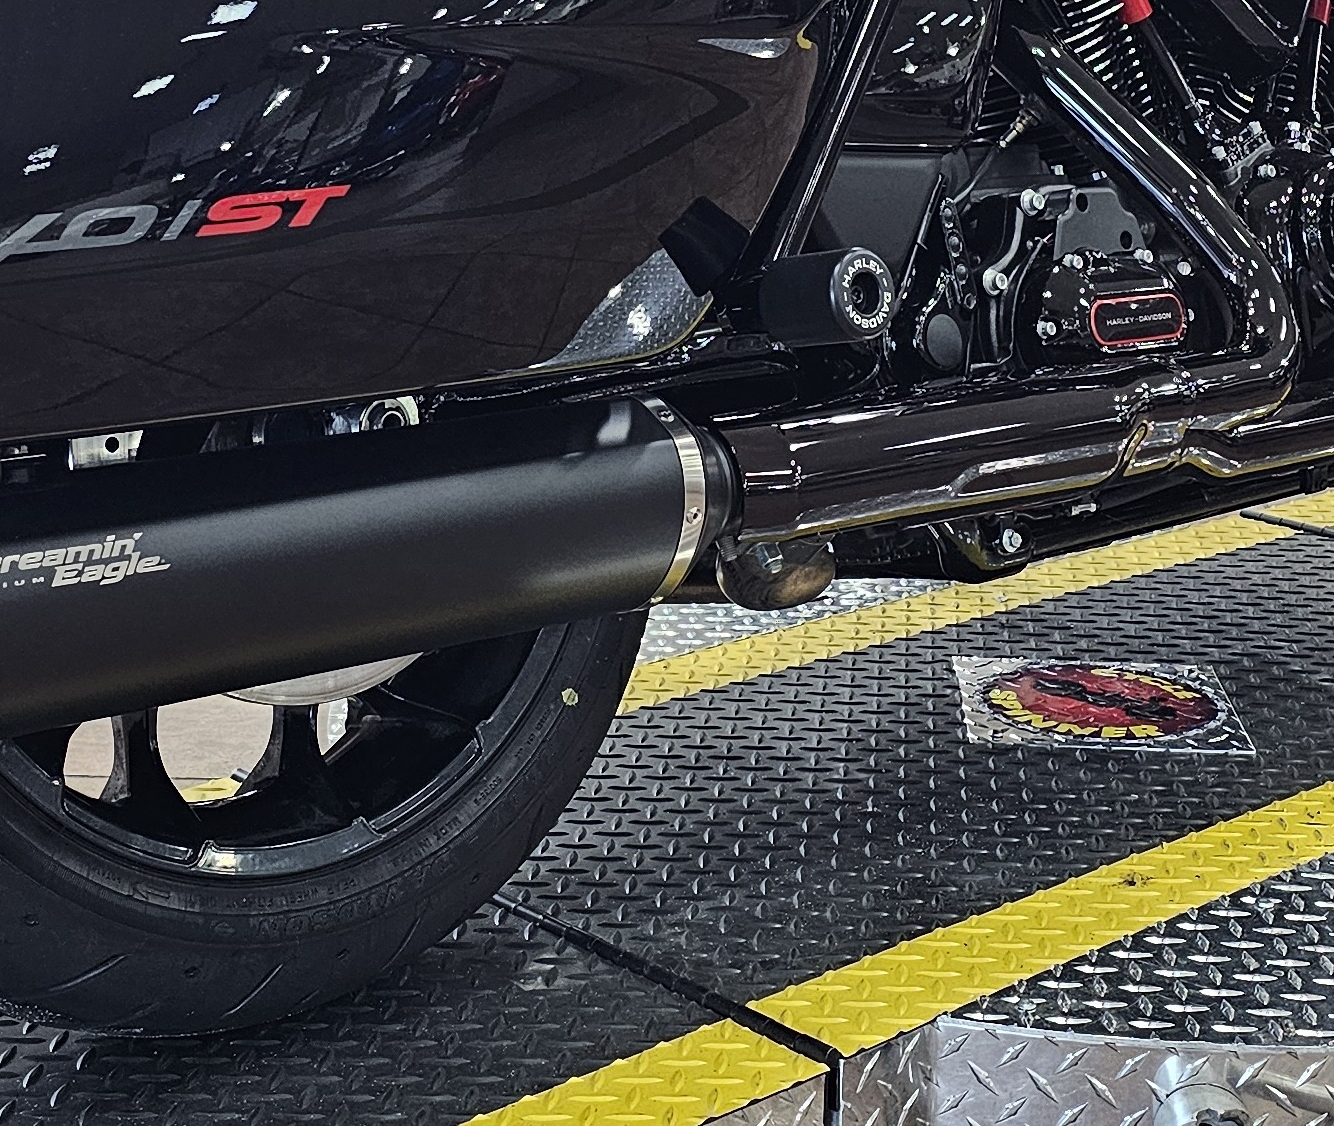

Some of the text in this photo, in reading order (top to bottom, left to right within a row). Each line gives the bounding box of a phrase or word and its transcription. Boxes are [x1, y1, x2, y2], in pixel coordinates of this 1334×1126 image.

[842, 257, 884, 289] HARLEY
[845, 292, 892, 329] DAVIDSON
[51, 551, 171, 588] Eagle
